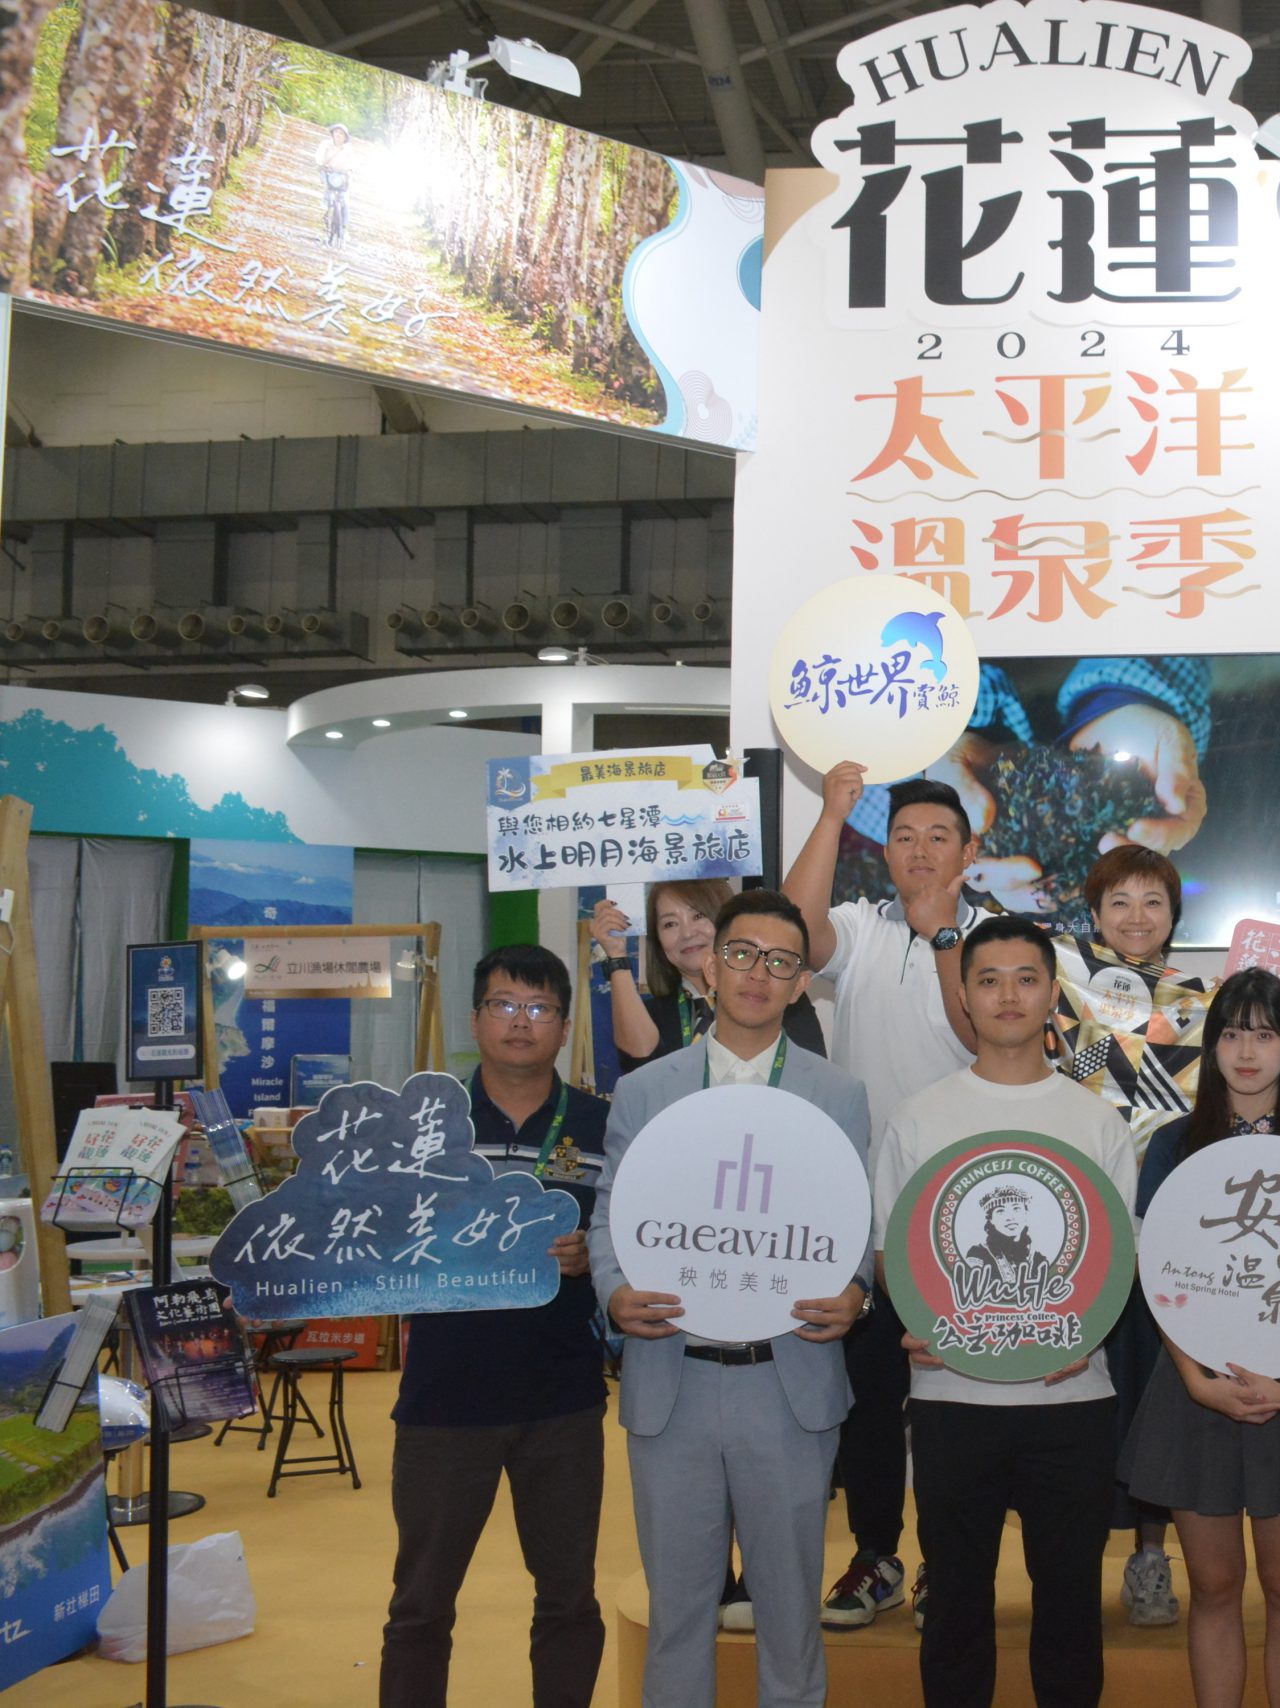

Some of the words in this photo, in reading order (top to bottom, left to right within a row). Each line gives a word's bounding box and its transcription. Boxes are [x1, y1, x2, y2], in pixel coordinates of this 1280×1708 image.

[860, 19, 1230, 106] HUALIEN
[51, 128, 238, 254] 花蓮
[831, 116, 1243, 309] 花蓮
[916, 329, 1191, 360] 2024
[850, 367, 1256, 483] 太平洋
[784, 650, 916, 719] 鯨世界
[579, 760, 667, 783] 最美海景旅店
[497, 804, 663, 837] 與您相約七星潭
[498, 828, 751, 874] 水上明月海景旅店
[316, 1096, 469, 1185] 花蓮
[953, 1159, 1014, 1196] PRINCESS
[1018, 1160, 1067, 1194] COFFEE
[234, 1191, 556, 1266] 依然美好
[635, 1219, 839, 1264] Gaeavilla
[375, 1274, 420, 1292] Still
[437, 1268, 537, 1289] Beautiful
[1174, 1280, 1189, 1292] Hot
[1190, 1282, 1217, 1296] Spring
[1217, 1286, 1240, 1298] Hotel
[984, 1312, 1025, 1323] Princess
[1027, 1312, 1057, 1322] Coffee
